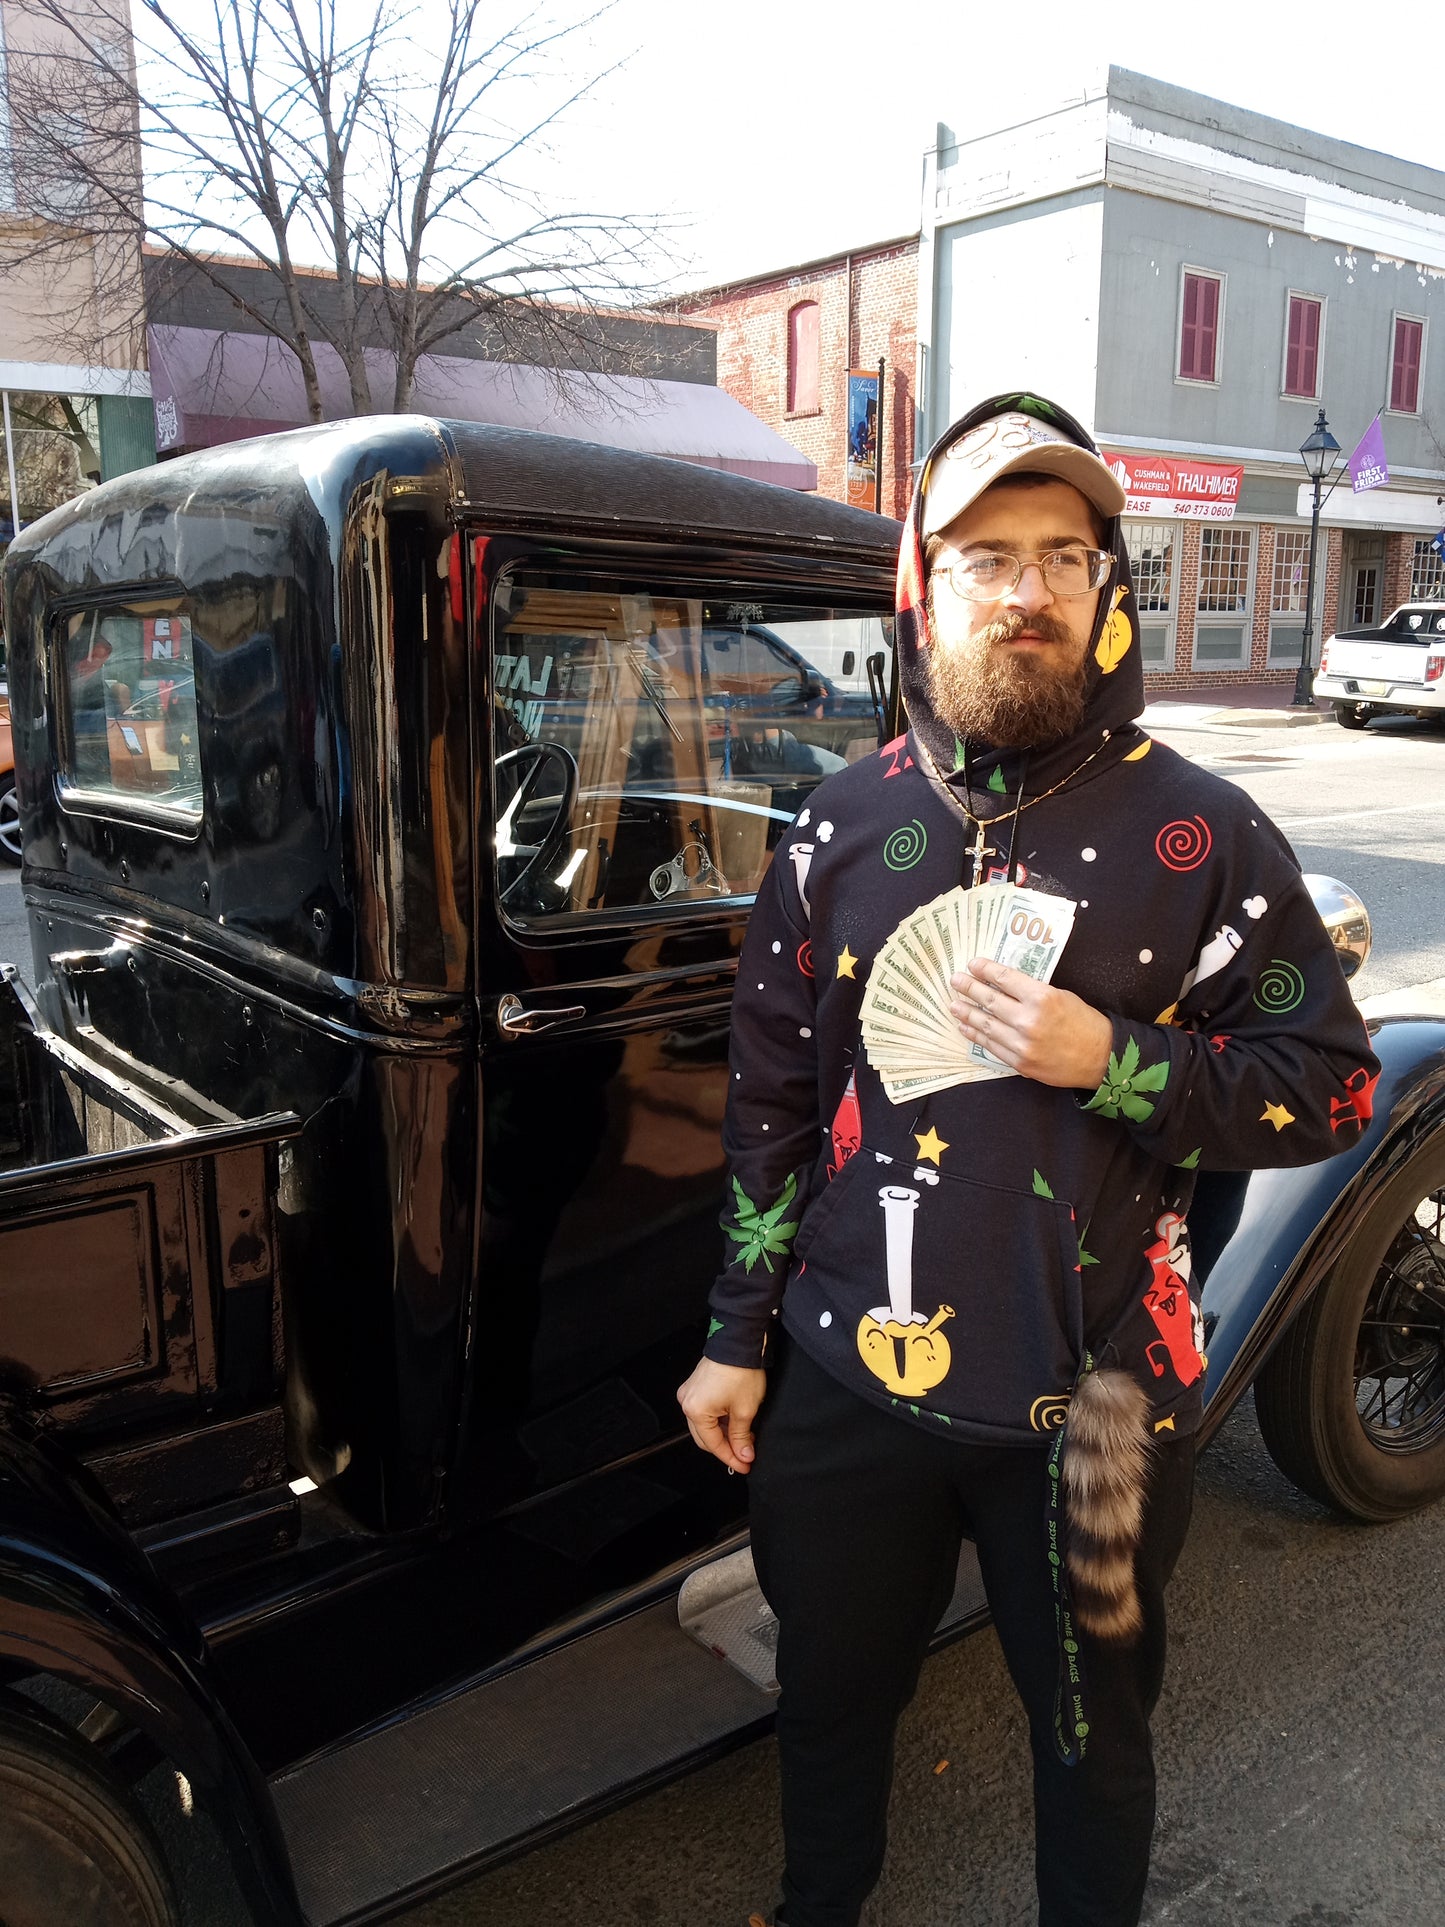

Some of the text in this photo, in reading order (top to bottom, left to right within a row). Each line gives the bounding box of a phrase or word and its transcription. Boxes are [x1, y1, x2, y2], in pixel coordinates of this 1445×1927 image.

[1134, 469, 1171, 480] CUSHMAN &
[1177, 473, 1238, 495] THALHIMER
[1354, 472, 1386, 488] FRIDAY
[1357, 466, 1381, 480] FIRST
[1133, 481, 1170, 492] WAKEFIELD
[1126, 500, 1233, 516] EASE 540 373 0600
[1010, 912, 1054, 944] 100
[1050, 1480, 1058, 1508] DIME
[1049, 1520, 1059, 1592] DIME BAGS
[1064, 1612, 1080, 1684] DIME BAGS
[1072, 1694, 1084, 1721] DIME
